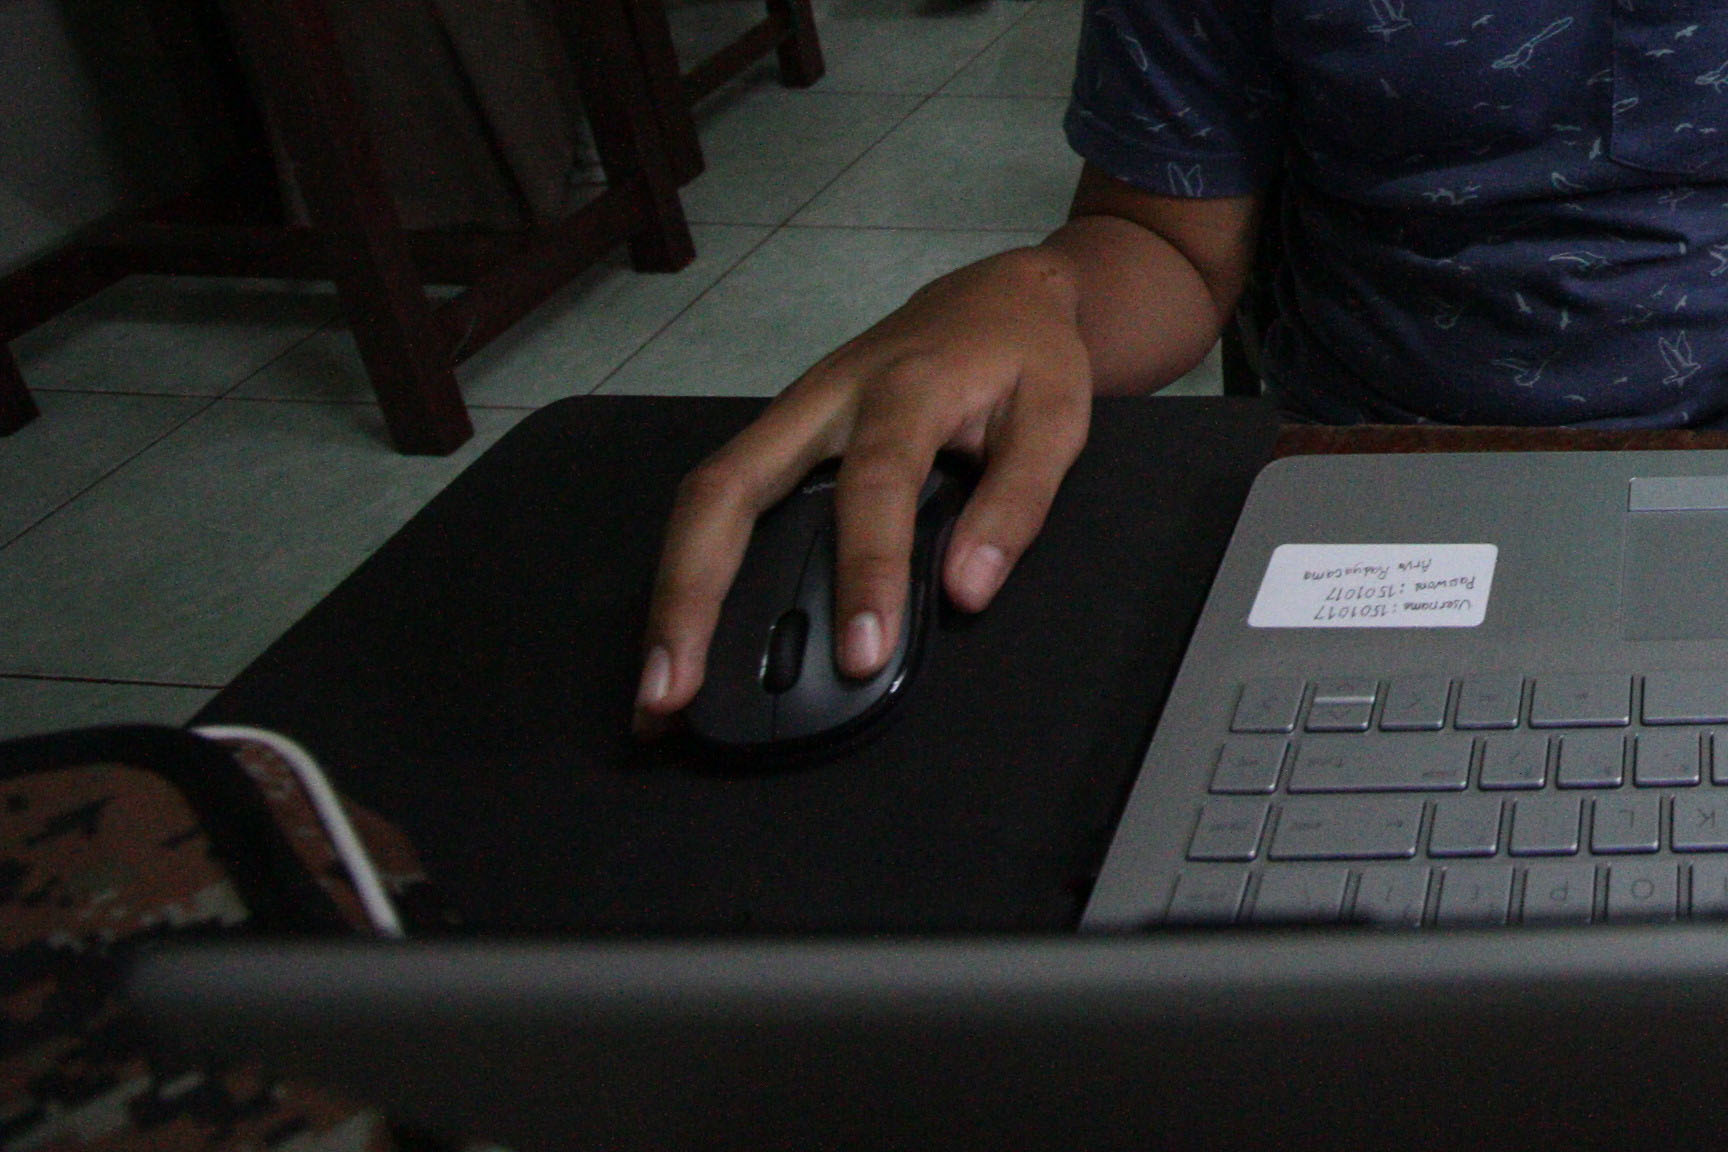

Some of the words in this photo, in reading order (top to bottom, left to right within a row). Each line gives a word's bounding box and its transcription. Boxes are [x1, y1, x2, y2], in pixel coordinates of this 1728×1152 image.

[1325, 585, 1395, 602] 1501017
[1313, 604, 1387, 620] 1501017
[1403, 599, 1471, 611] Username
[1619, 809, 1635, 828] L
[1697, 808, 1716, 827] K
[1549, 882, 1568, 902] P
[1630, 879, 1655, 900] O
